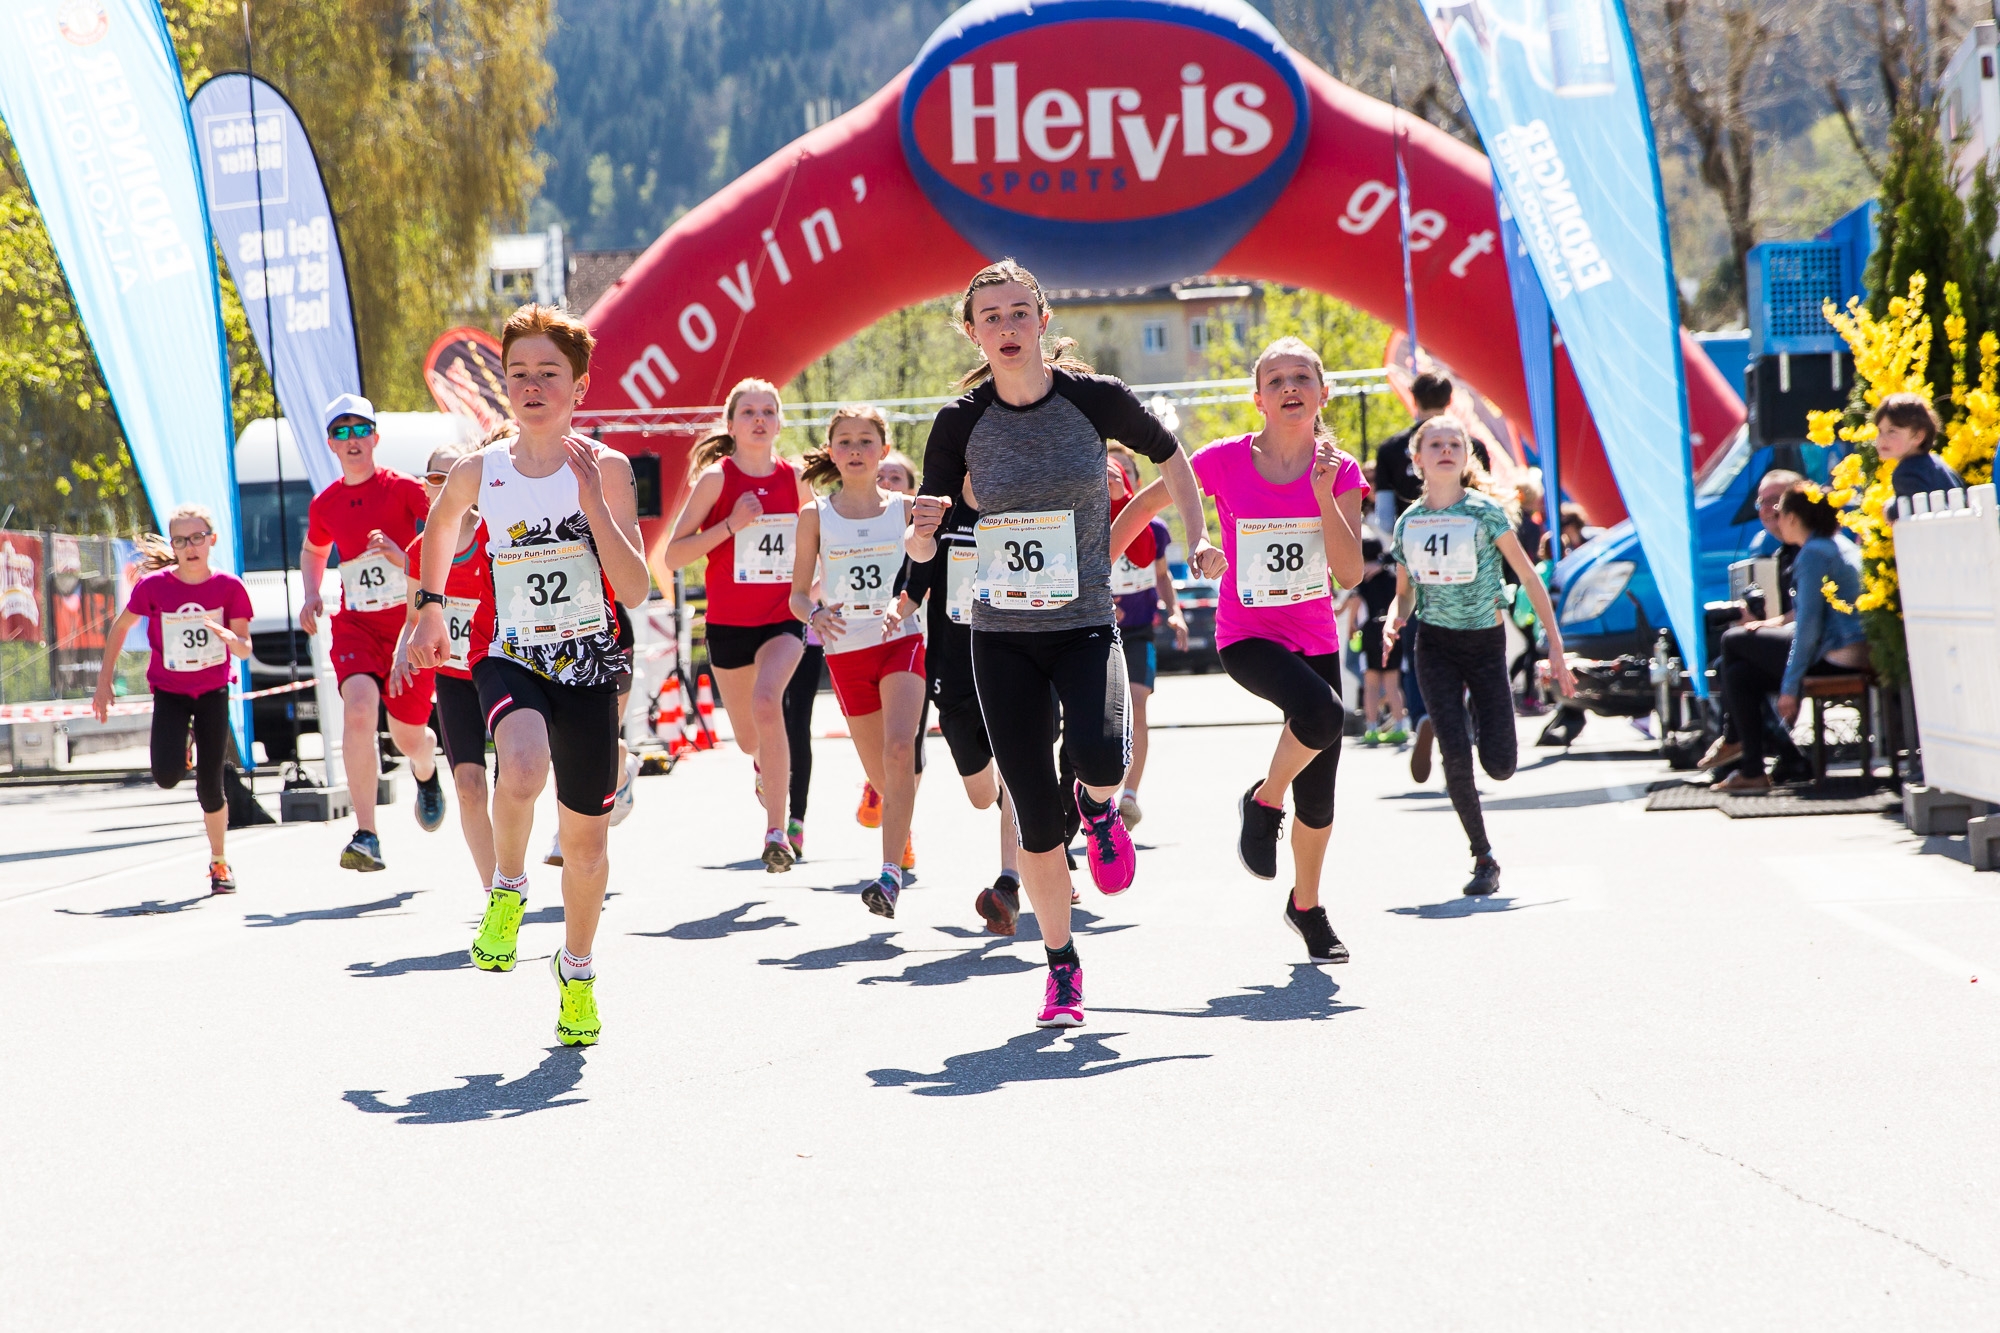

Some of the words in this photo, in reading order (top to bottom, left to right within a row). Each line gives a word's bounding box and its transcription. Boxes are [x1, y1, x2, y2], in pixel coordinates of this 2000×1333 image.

[948, 61, 1273, 181] Hervis
[979, 167, 1127, 195] SPORTS
[1337, 180, 1496, 278] get
[981, 517, 1002, 525] Happy
[1243, 522, 1266, 530] Happy
[1268, 521, 1322, 529] Run-InnSBRUC
[498, 552, 522, 560] Happy
[758, 533, 785, 556] 44
[954, 550, 975, 558] Happy
[1004, 540, 1045, 572] 36
[1424, 533, 1449, 556] 41
[1266, 543, 1304, 572] 38
[360, 566, 385, 589] 43
[526, 571, 571, 606] 32
[849, 564, 882, 591] 33
[183, 628, 208, 648] 39
[450, 616, 471, 642] 64
[933, 678, 942, 694] 5
[472, 942, 517, 962] ROOK
[557, 1020, 602, 1038] ROOK
